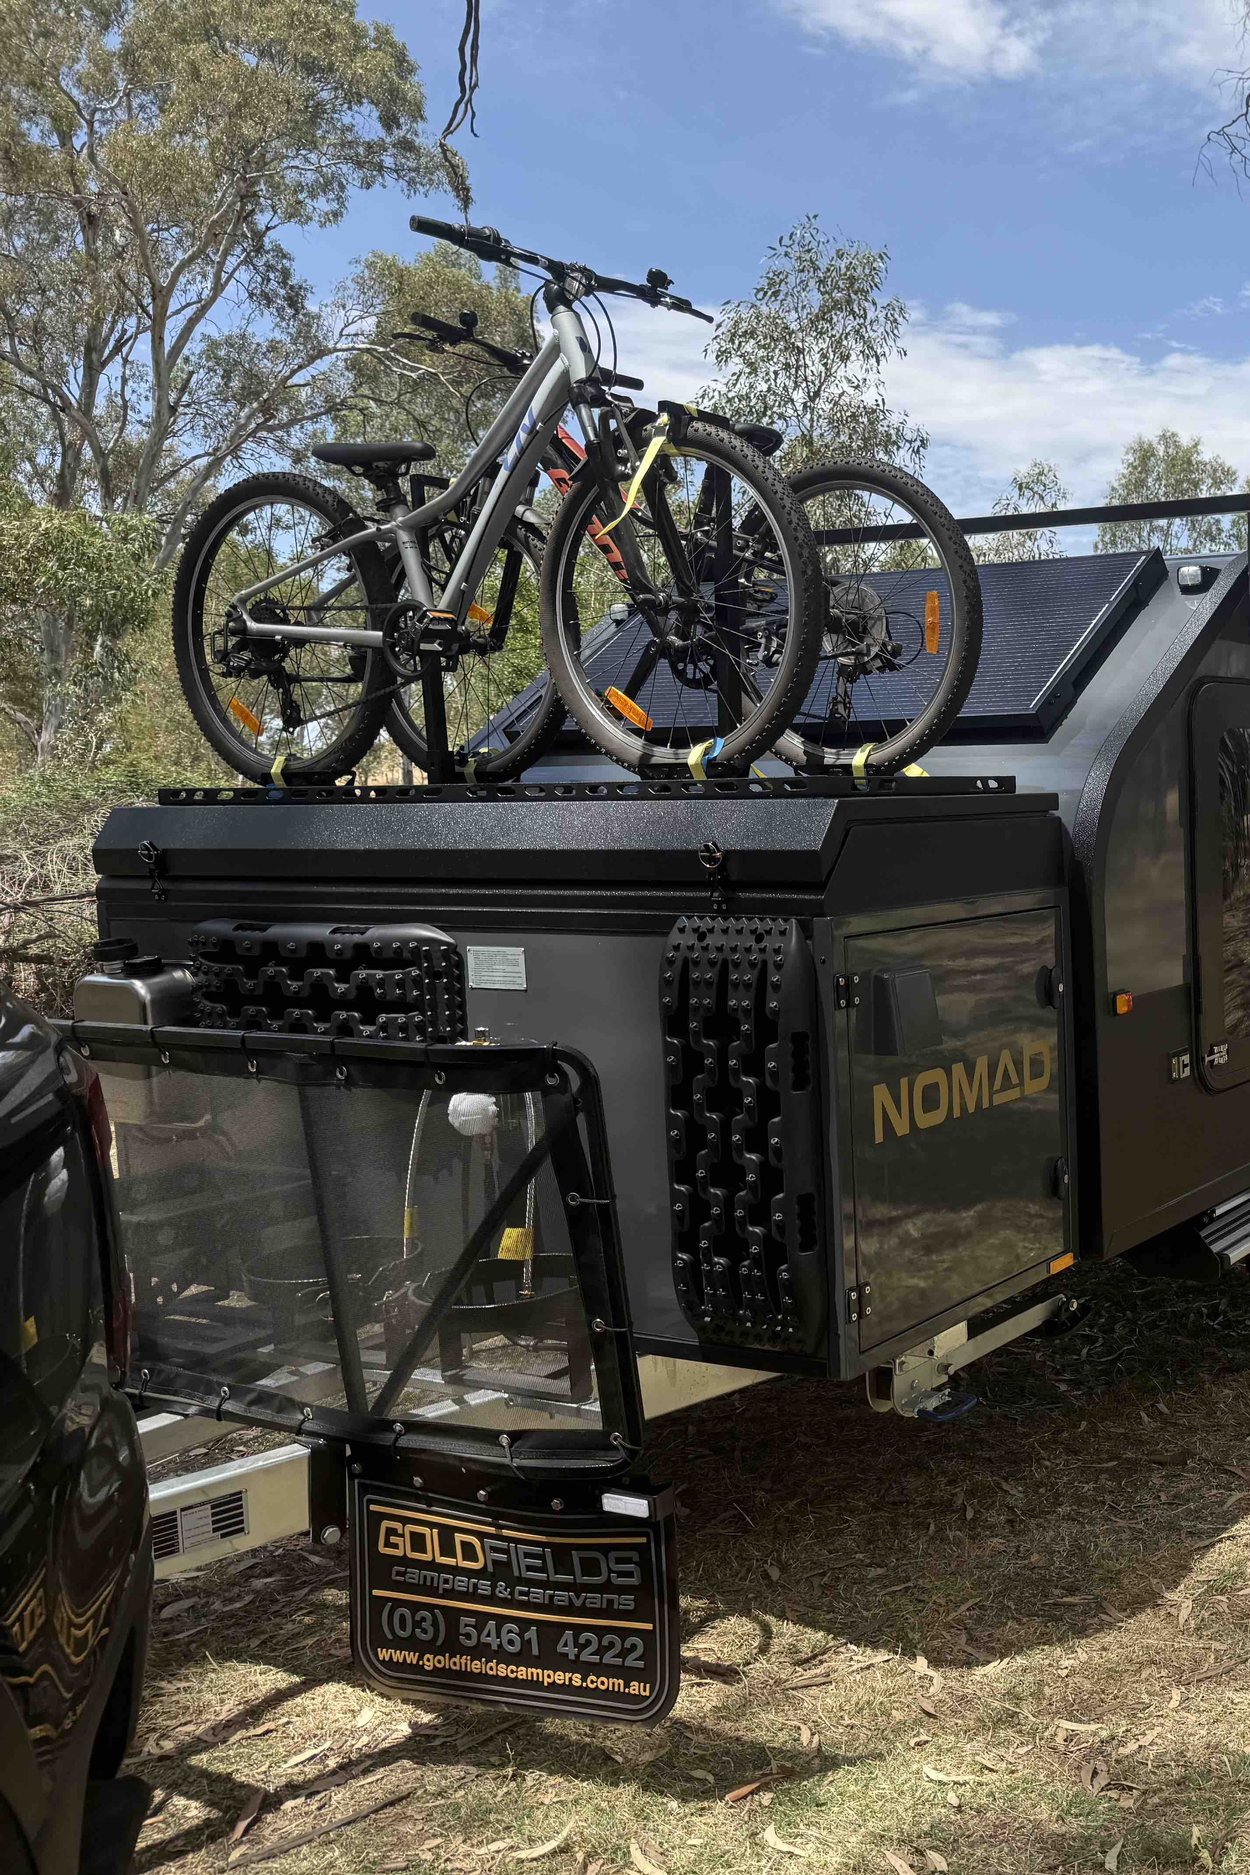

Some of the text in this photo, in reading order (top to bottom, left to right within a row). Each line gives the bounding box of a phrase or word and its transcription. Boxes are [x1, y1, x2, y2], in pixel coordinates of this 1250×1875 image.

[872, 1040, 1051, 1144] NOMAD
[377, 1519, 643, 1586] GOLDFIELDS
[391, 1565, 635, 1611] campers & caravans
[381, 1602, 646, 1669] (03) 5461 4222
[377, 1647, 651, 1697] www.goldfieldscampers.com.au
